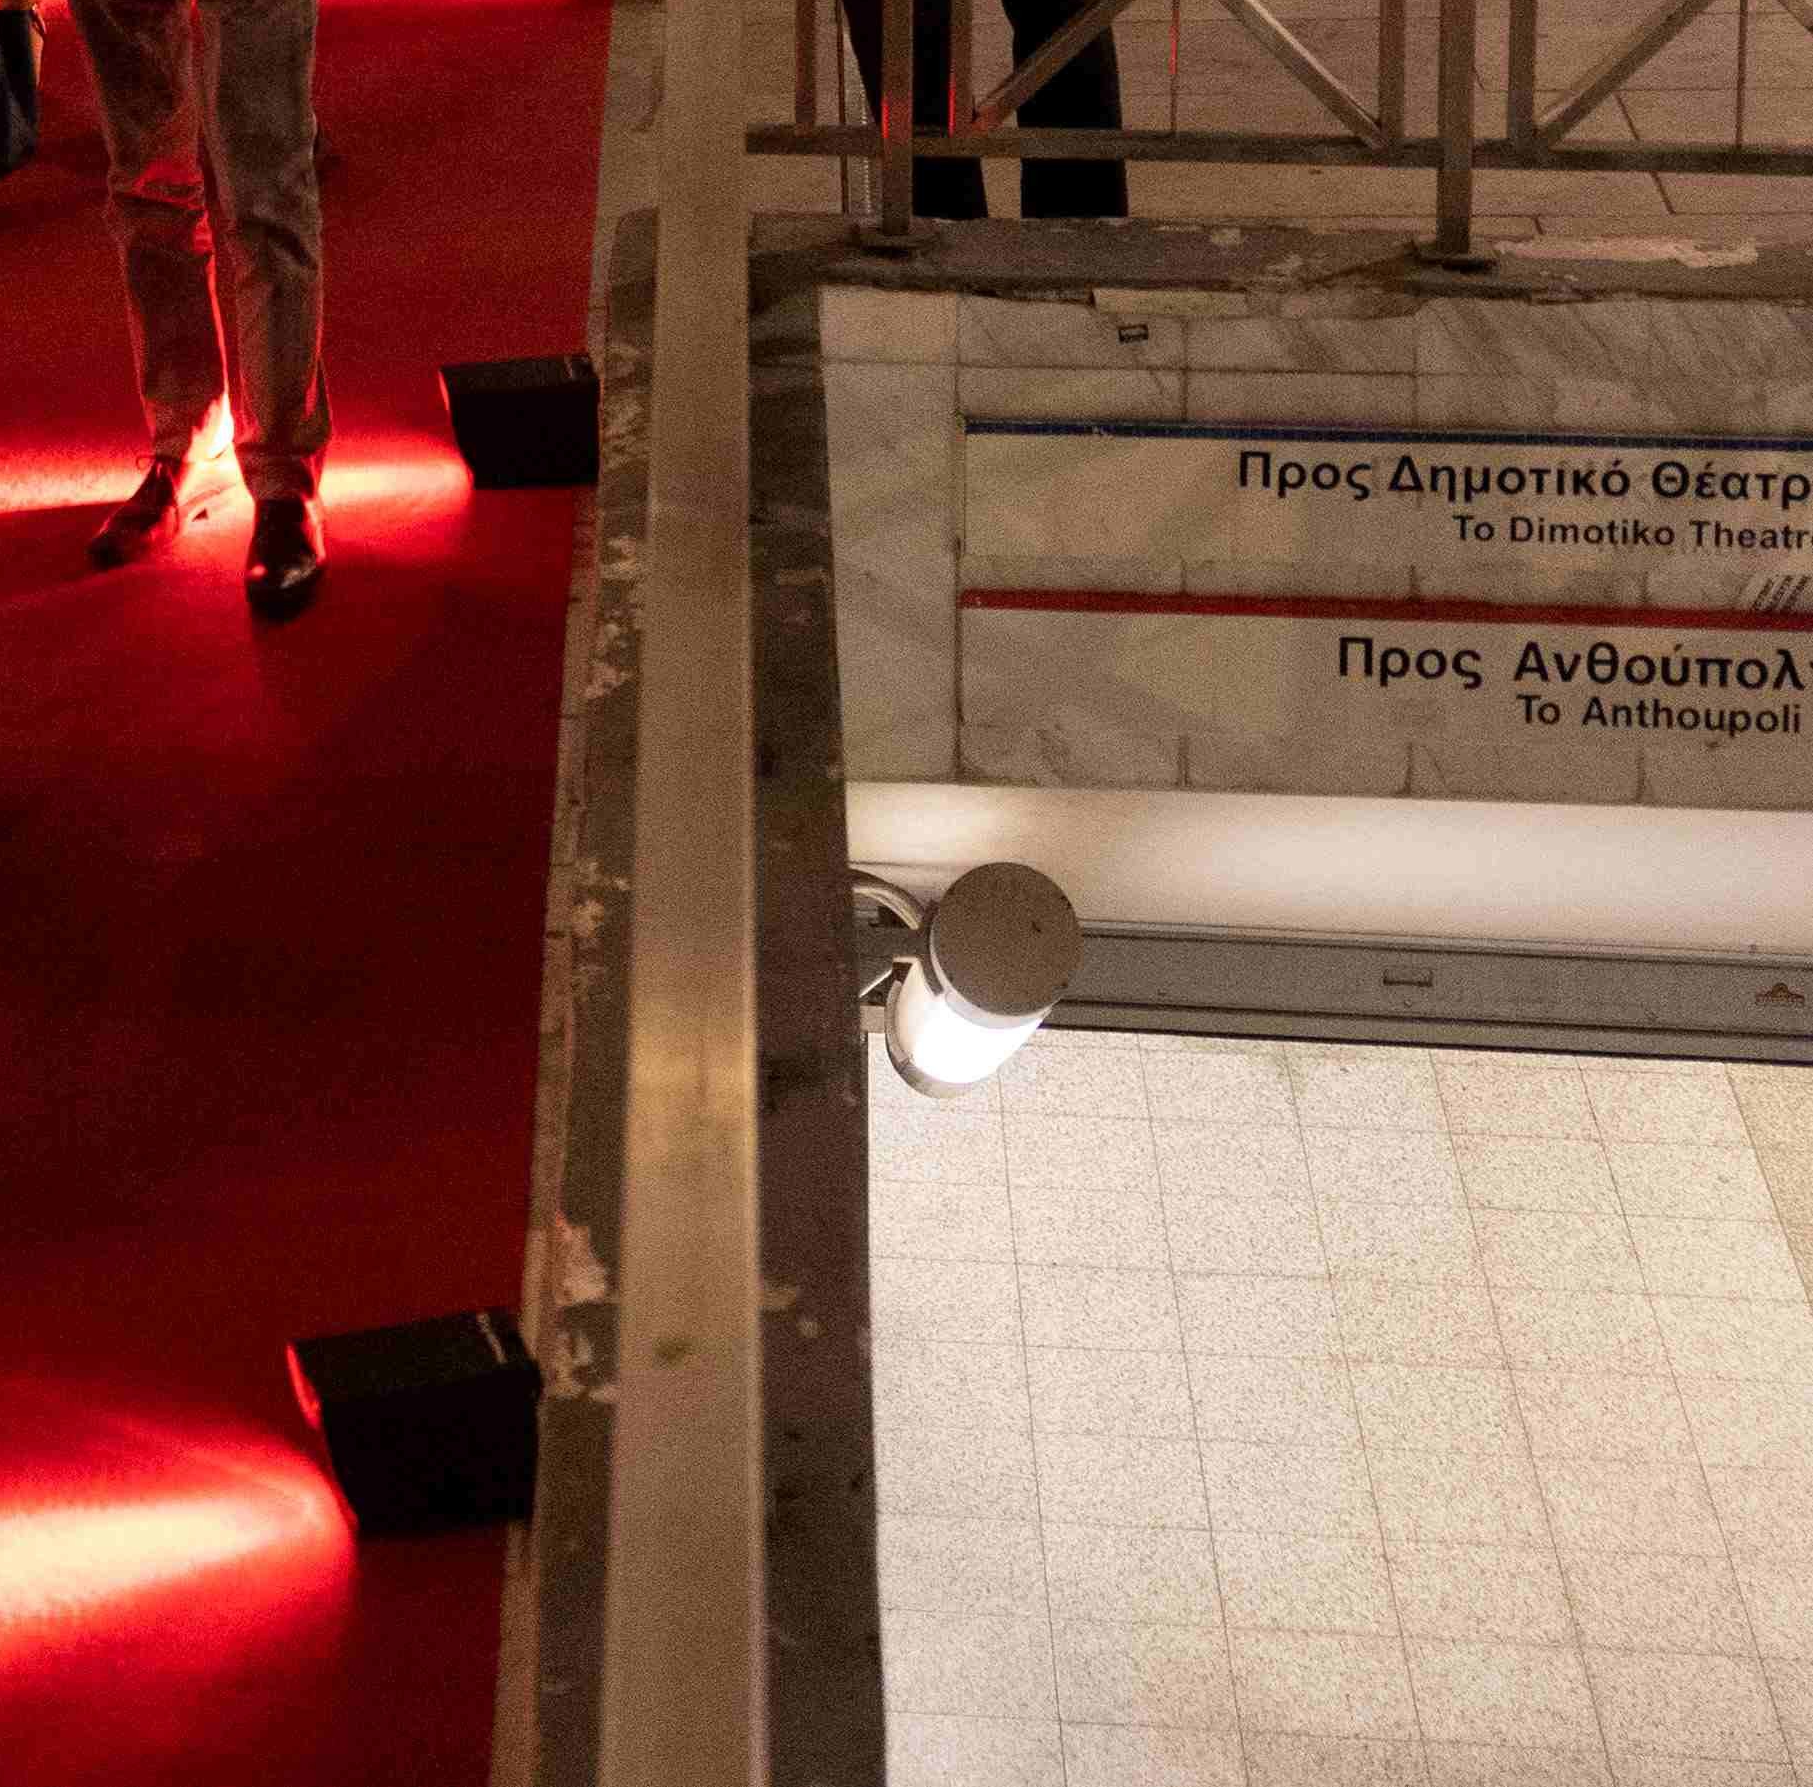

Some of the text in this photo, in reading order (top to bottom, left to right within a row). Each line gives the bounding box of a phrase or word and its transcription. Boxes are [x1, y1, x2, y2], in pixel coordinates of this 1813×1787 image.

[1239, 450, 1813, 510] Προς Δημοτικό Θέατρ
[1452, 514, 1813, 550] To Dimotiko Theatr
[1338, 636, 1813, 691] Προς Ανθούπολ
[1515, 694, 1802, 738] To Anthoupoli
